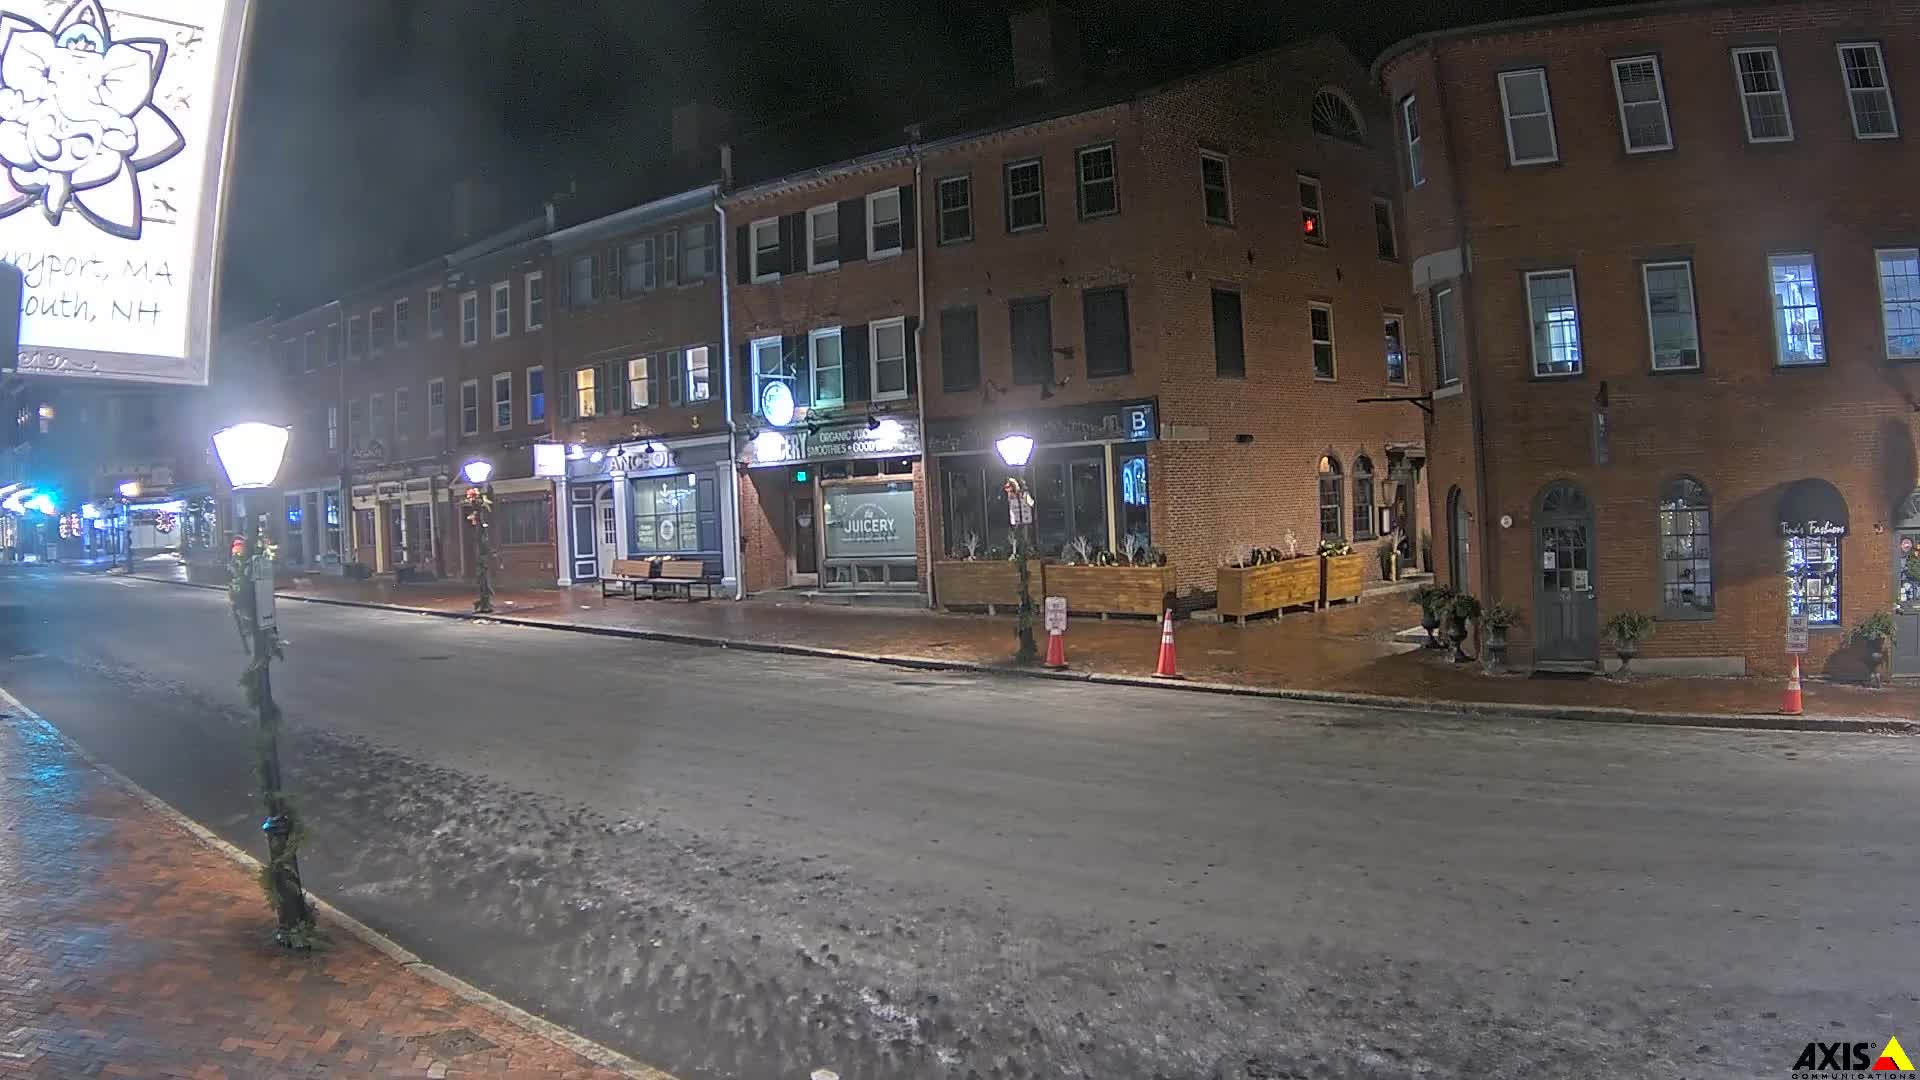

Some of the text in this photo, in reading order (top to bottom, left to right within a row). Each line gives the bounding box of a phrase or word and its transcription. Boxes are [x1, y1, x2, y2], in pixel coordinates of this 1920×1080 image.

[124, 258, 173, 287] MA
[22, 291, 161, 327] outh, NH
[819, 430, 851, 443] ORGANIC
[807, 444, 847, 457] SMOOTHIES
[844, 518, 895, 533] JUICERY
